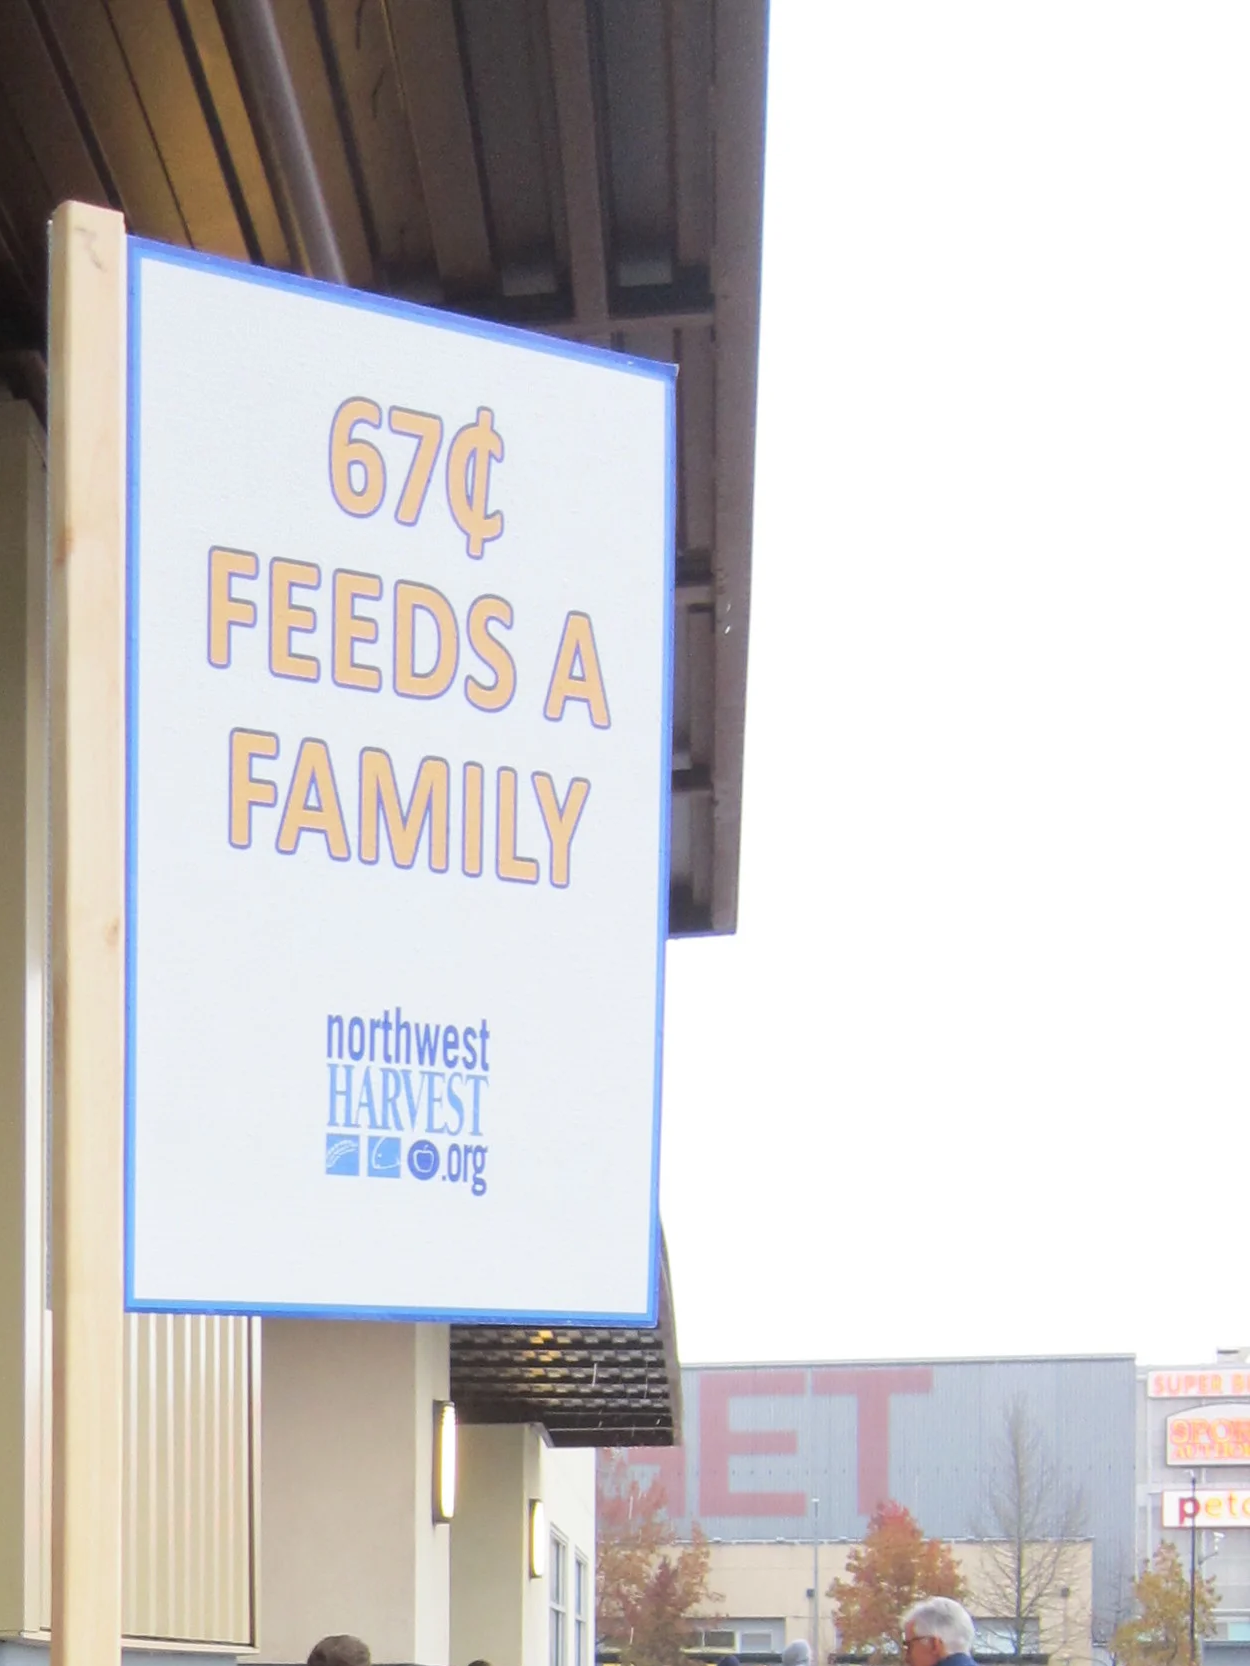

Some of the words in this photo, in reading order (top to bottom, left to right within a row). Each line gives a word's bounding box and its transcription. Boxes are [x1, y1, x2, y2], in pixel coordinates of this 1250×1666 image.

[329, 396, 504, 560] 67¢
[207, 545, 517, 713] FEEDS
[543, 610, 611, 730] A
[228, 726, 591, 889] FAMILY
[326, 1006, 490, 1071] northwest
[326, 1063, 490, 1136] HARVEST
[441, 1143, 488, 1196] .org
[1154, 1373, 1223, 1396] SUPER
[1231, 1371, 1250, 1394] B
